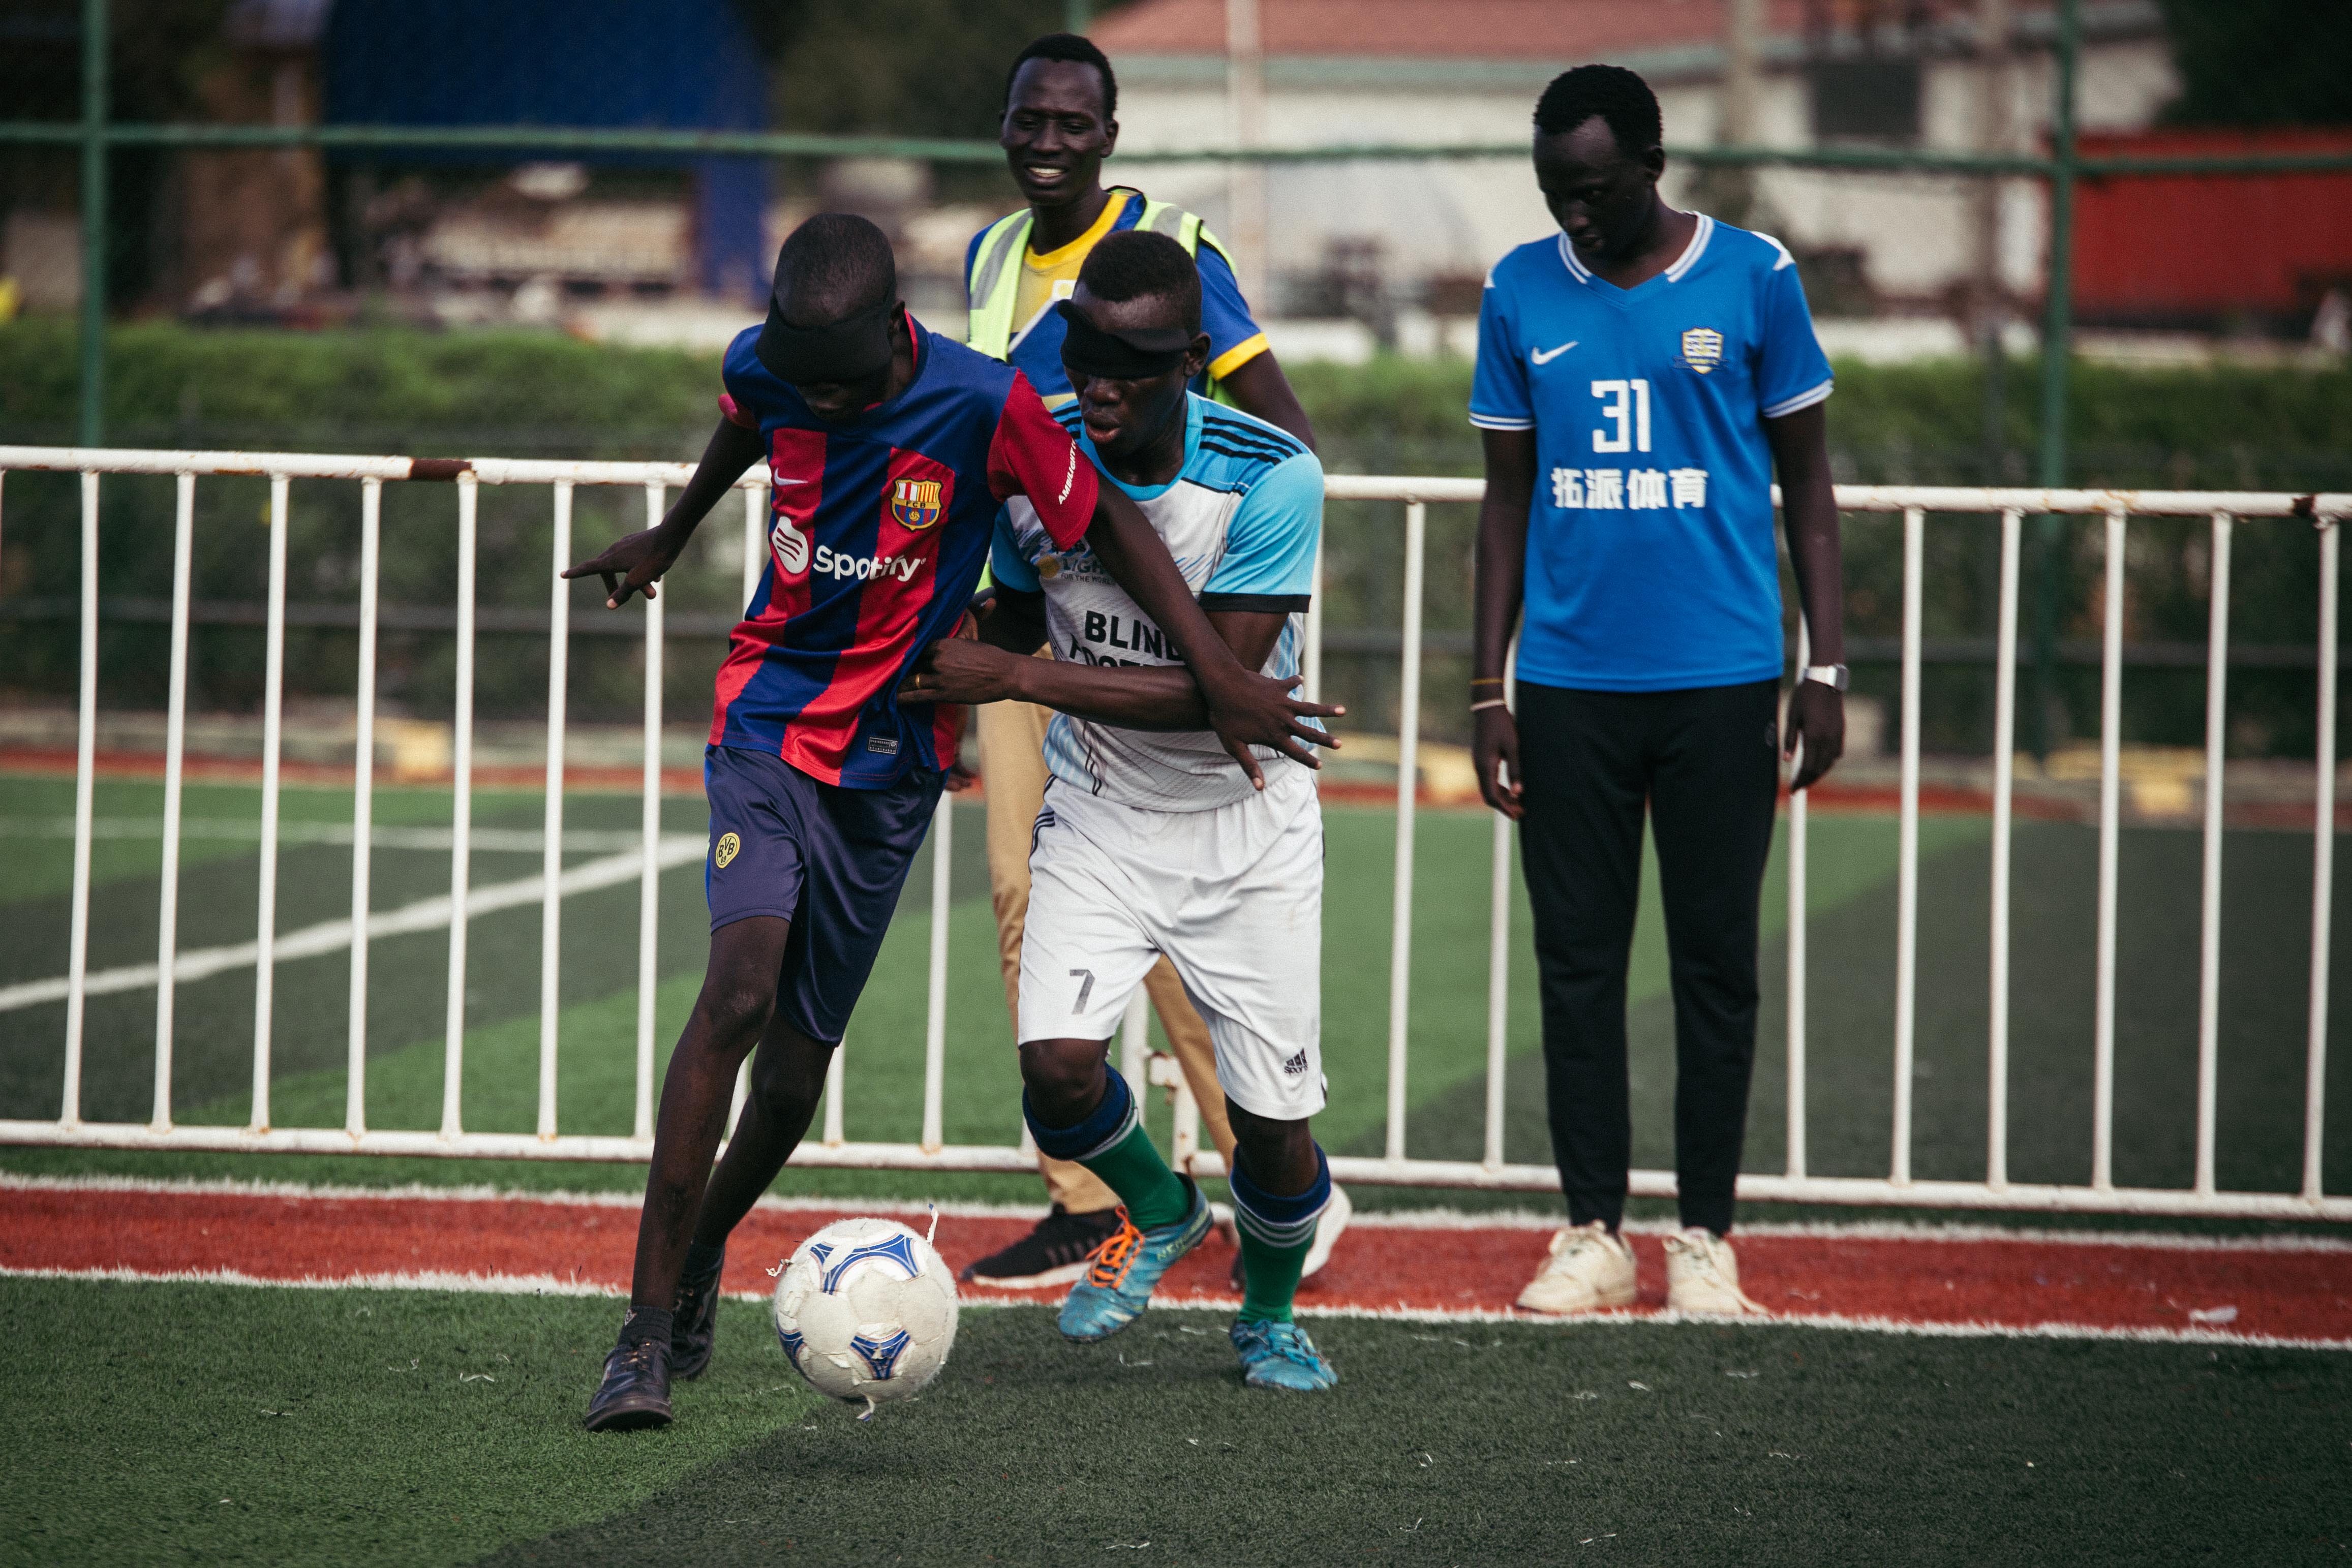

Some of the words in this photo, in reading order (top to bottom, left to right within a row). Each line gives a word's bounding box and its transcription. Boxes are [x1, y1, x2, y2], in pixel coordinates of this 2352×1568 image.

[1591, 379, 1651, 452] 31
[1058, 447, 1076, 505] AMBILIGHT
[1551, 467, 1709, 510] 拓派体育
[813, 545, 921, 582] Spotify
[1063, 558, 1109, 574] LIGH
[719, 838, 735, 857] BVB
[720, 855, 727, 864] 09
[1069, 969, 1095, 1015] 7
